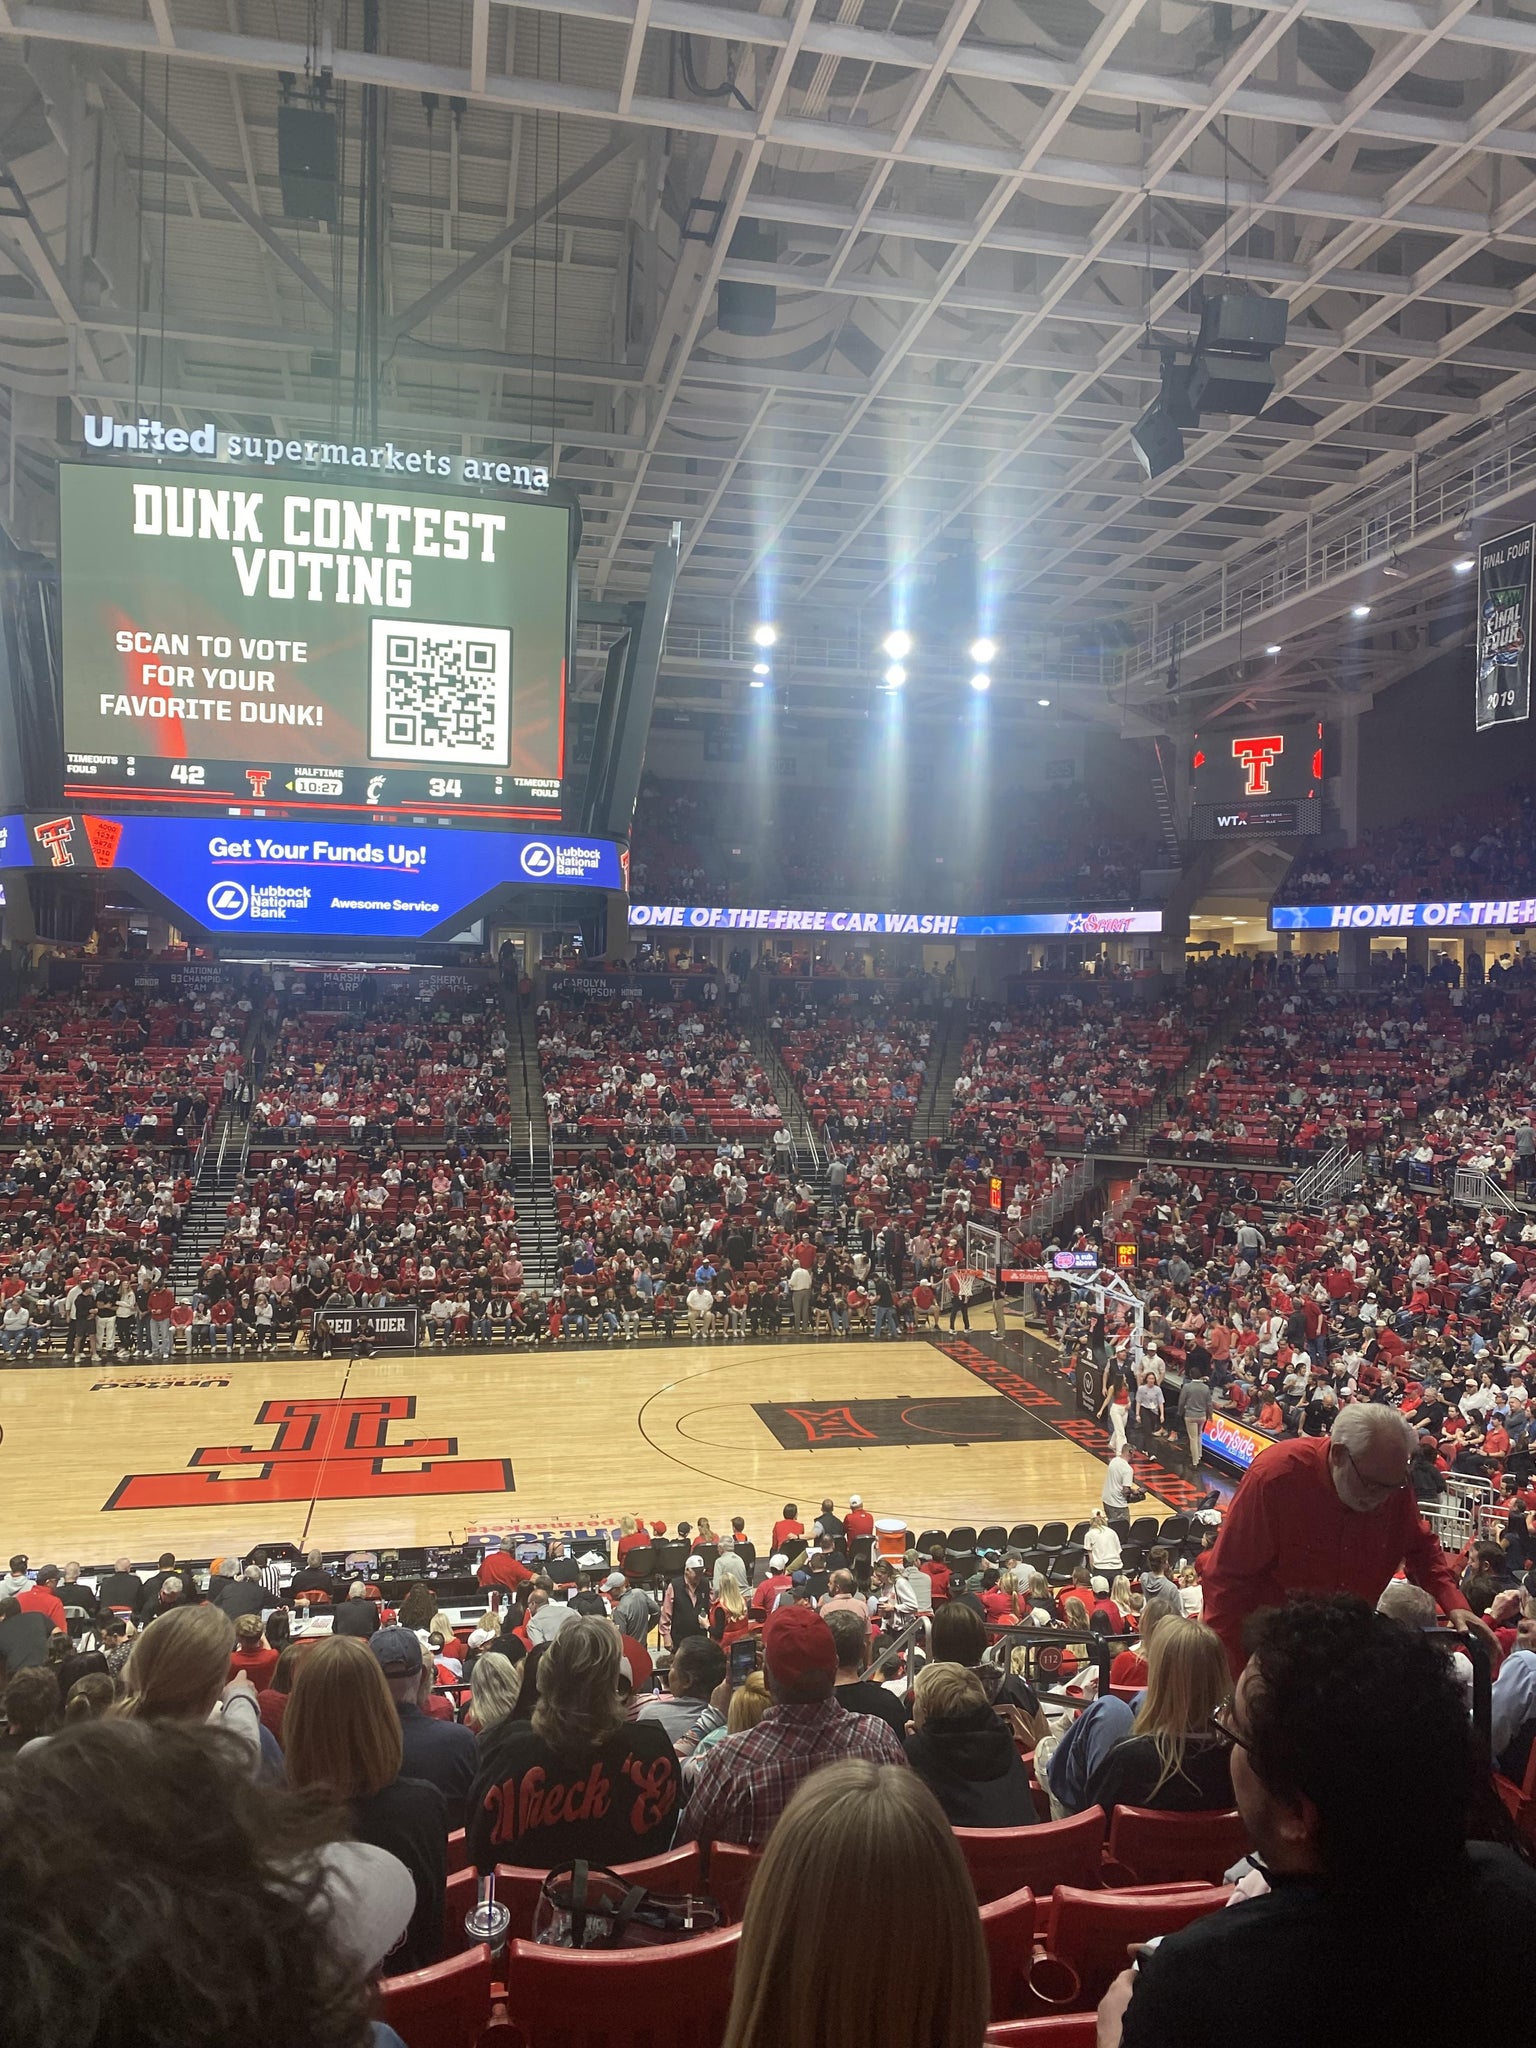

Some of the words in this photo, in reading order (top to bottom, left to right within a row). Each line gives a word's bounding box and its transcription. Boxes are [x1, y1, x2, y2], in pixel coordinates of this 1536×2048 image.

[84, 415, 214, 453] United
[227, 436, 451, 476] supermarkets
[464, 458, 549, 488] arena
[133, 484, 263, 542] DUNK
[284, 495, 505, 562] CONTEST
[1483, 554, 1505, 571] FINAL
[1507, 540, 1530, 561] FOUR
[232, 546, 412, 608] VOTING
[116, 630, 189, 656] SCAN
[196, 635, 231, 658] TO
[239, 638, 307, 663] VOTE
[142, 664, 194, 688] FOR
[201, 667, 275, 692] YOUR
[1487, 690, 1515, 709] 2019
[100, 693, 231, 721] FAVORITE
[240, 701, 323, 727] DUNK!
[67, 754, 118, 765] TIMEOUTS
[127, 756, 135, 765] 3
[67, 765, 97, 774] FOULS
[127, 767, 135, 776] 6
[170, 764, 205, 785] 42
[294, 768, 344, 778] HALFTIME
[299, 781, 339, 793] 10:27
[429, 777, 463, 798] 34
[495, 776, 503, 785] 3
[514, 777, 560, 789] TIMEOUTS
[495, 786, 503, 795] 6
[531, 788, 559, 798] FOULS
[209, 837, 251, 858] Get
[255, 838, 309, 860] Your
[313, 841, 384, 863] Funds
[388, 844, 427, 868] Up!
[556, 845, 601, 859] Lubbock
[556, 856, 599, 868] National
[556, 866, 584, 877] Bank
[250, 885, 312, 898] Lubbock
[250, 895, 308, 909] National
[330, 897, 390, 910] Awesome
[393, 900, 439, 912] Service
[250, 907, 286, 918] Bank
[1331, 904, 1416, 927] HOME
[1422, 903, 1461, 925] OF
[1470, 901, 1521, 924] THE
[690, 907, 723, 926] OF
[728, 908, 771, 928] THE
[774, 909, 827, 930] FREE
[831, 912, 878, 931] CAR
[884, 914, 958, 935] WASH!
[171, 975, 182, 983] 93
[430, 975, 468, 985] SHERYL
[552, 982, 563, 991] 44
[935, 1340, 1012, 1374] TEXAS
[986, 1374, 1062, 1406] TECH
[89, 1379, 230, 1392] United
[1209, 1418, 1255, 1457] Surfside
[1044, 1655, 1058, 1664] 112
[484, 1762, 612, 1845] Wreck
